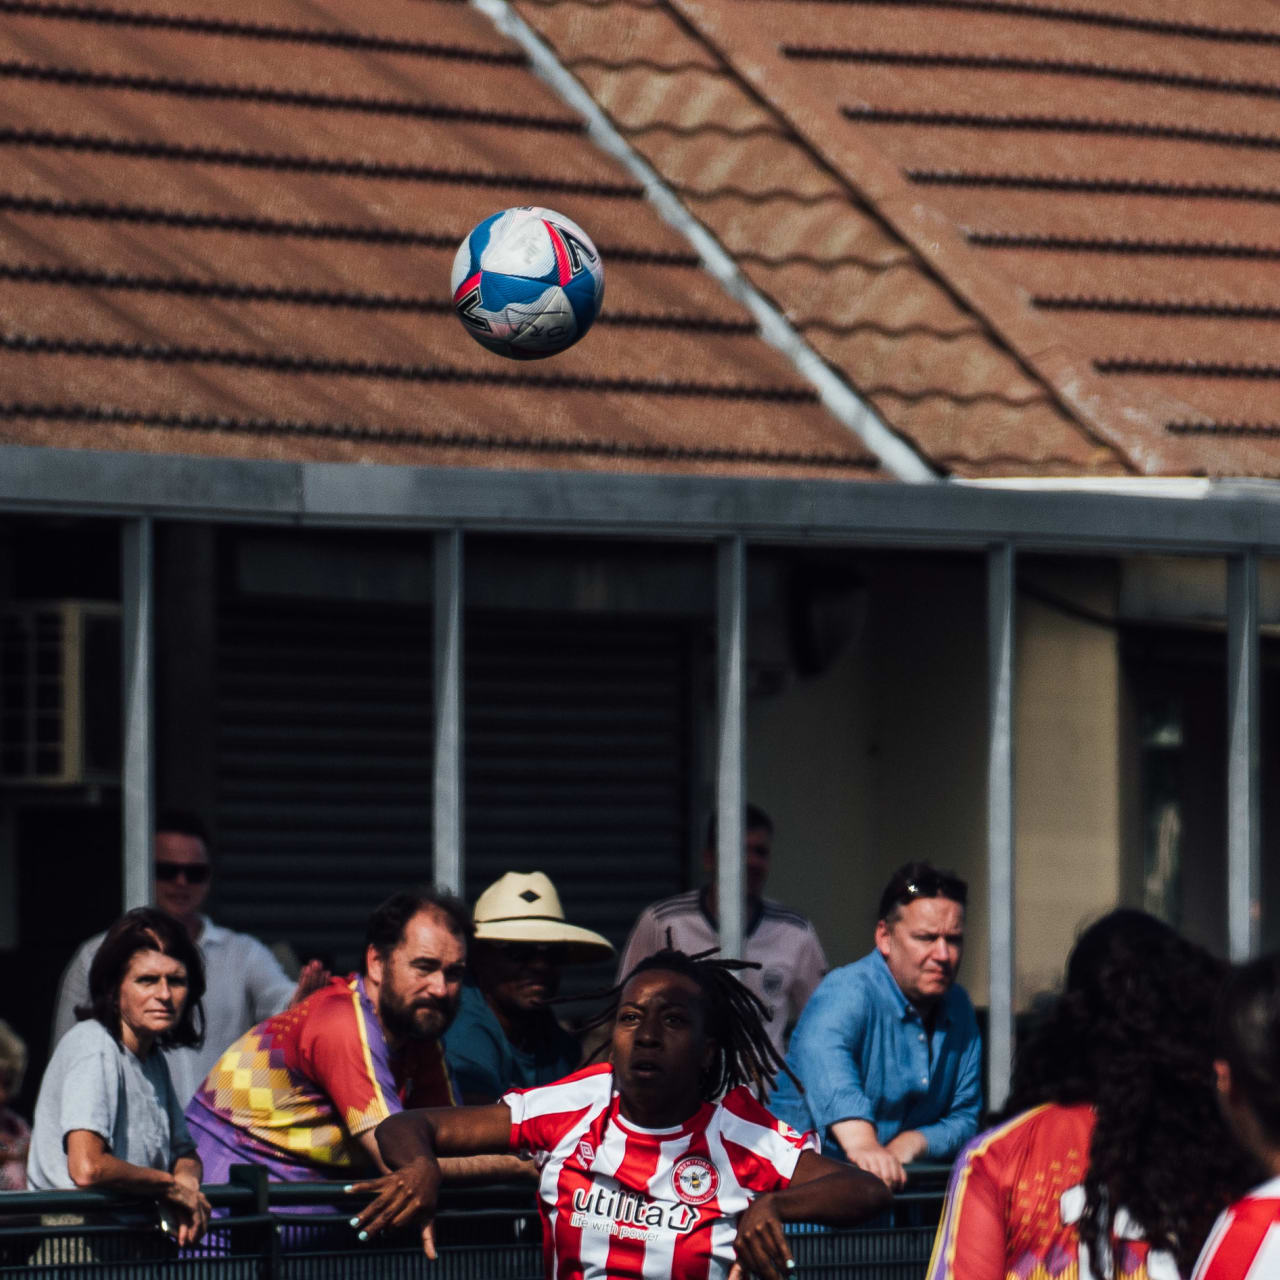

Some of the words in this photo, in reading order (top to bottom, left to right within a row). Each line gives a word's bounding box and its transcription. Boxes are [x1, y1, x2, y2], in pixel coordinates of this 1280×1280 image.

[575, 1188, 663, 1227] utilita
[571, 1215, 588, 1229] life
[592, 1222, 618, 1236] with
[620, 1228, 659, 1243] power
